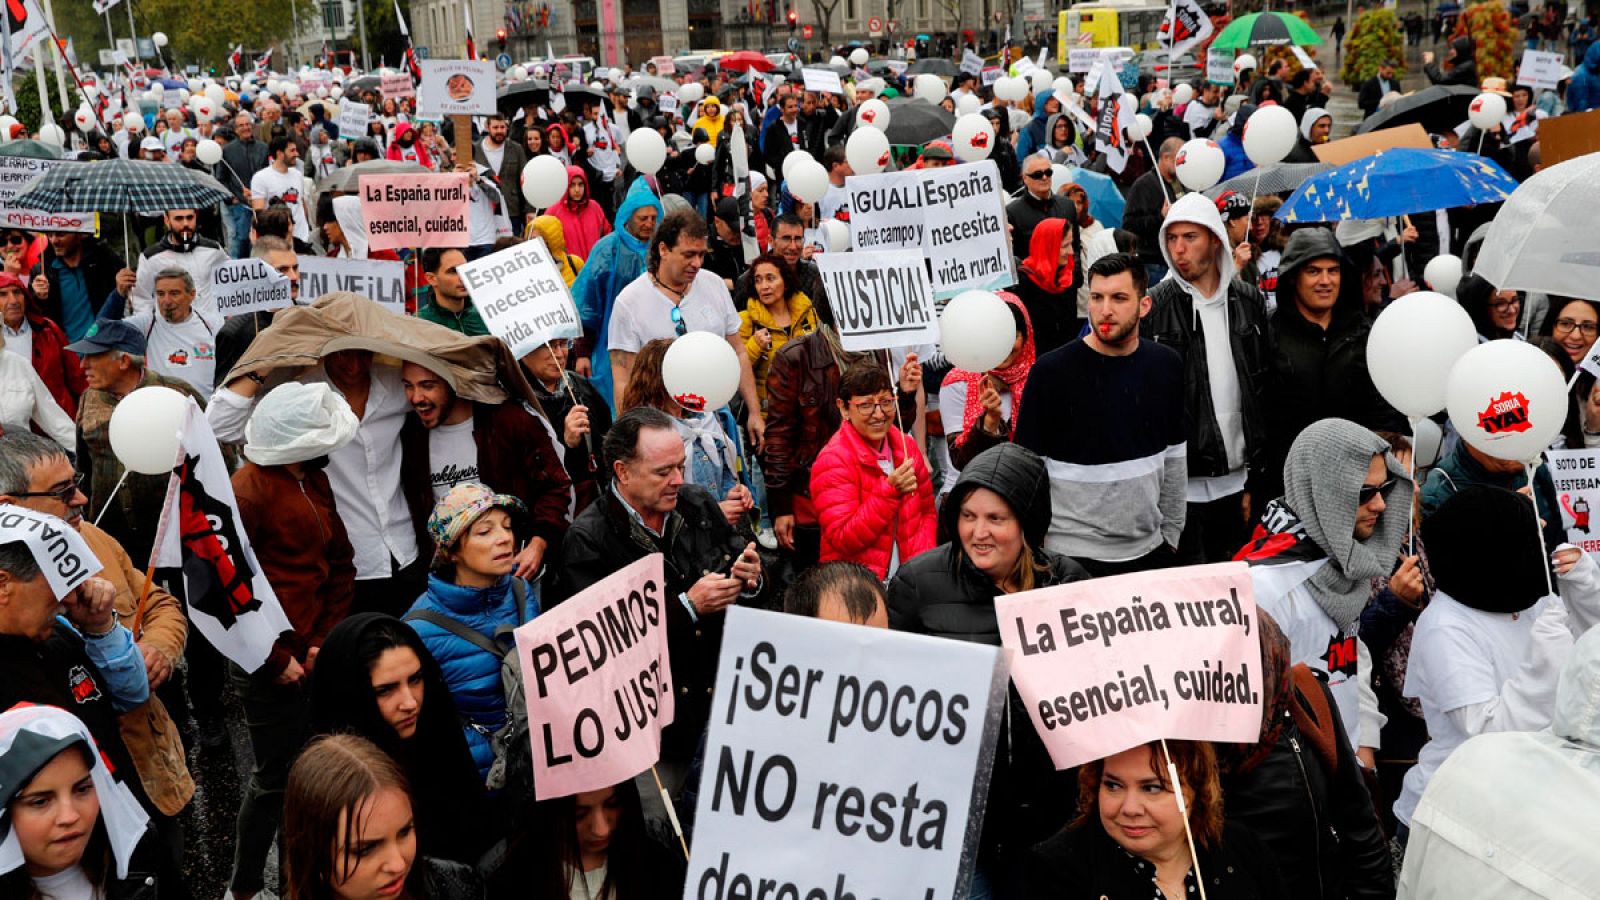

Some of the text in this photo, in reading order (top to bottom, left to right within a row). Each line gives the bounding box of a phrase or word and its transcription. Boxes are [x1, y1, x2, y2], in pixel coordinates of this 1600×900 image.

[366, 183, 466, 206] La España rural,
[923, 170, 993, 209] España
[8, 213, 81, 228] MACHADO
[370, 214, 467, 236] esencial, cuidad.
[880, 224, 914, 247] campo
[917, 224, 923, 246] y
[931, 210, 1000, 246] necesita
[464, 250, 543, 291] España
[938, 248, 1007, 285] vida rural.
[484, 277, 559, 319] necesita
[502, 304, 574, 348] vida rural.
[1482, 407, 1527, 432] ¡YA!
[1493, 397, 1520, 414] SORIA
[1556, 457, 1595, 470] SOTO DE
[531, 580, 660, 698] PEDIMOS
[1016, 587, 1250, 656] La España rural,
[725, 641, 969, 745] ¡Ser pocos
[1038, 660, 1258, 731] esencial, cuidad.
[542, 708, 605, 768] LO
[711, 745, 948, 851] NO resta
